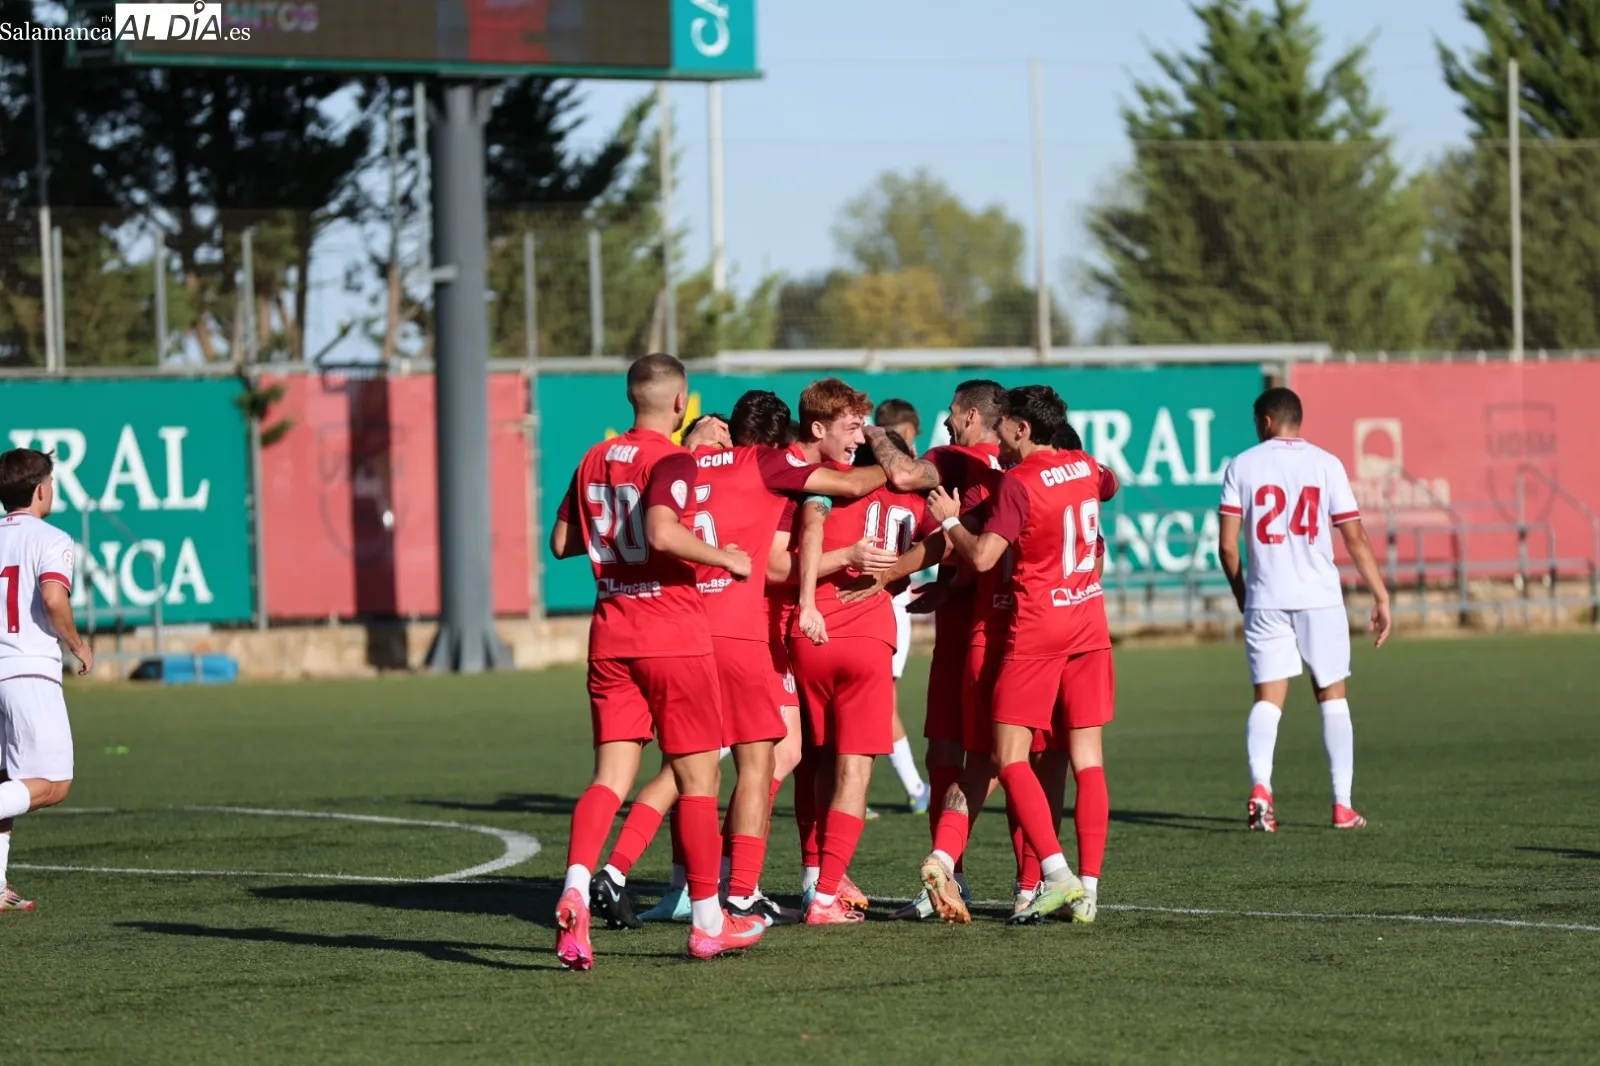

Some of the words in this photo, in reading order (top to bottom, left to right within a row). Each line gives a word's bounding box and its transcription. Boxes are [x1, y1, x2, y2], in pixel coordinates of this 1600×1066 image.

[696, 451, 734, 468] CON
[587, 483, 650, 565] 20
[864, 501, 917, 556] 10
[1062, 498, 1100, 579] 19
[1254, 484, 1321, 545] 24
[72, 537, 214, 606] NCA
